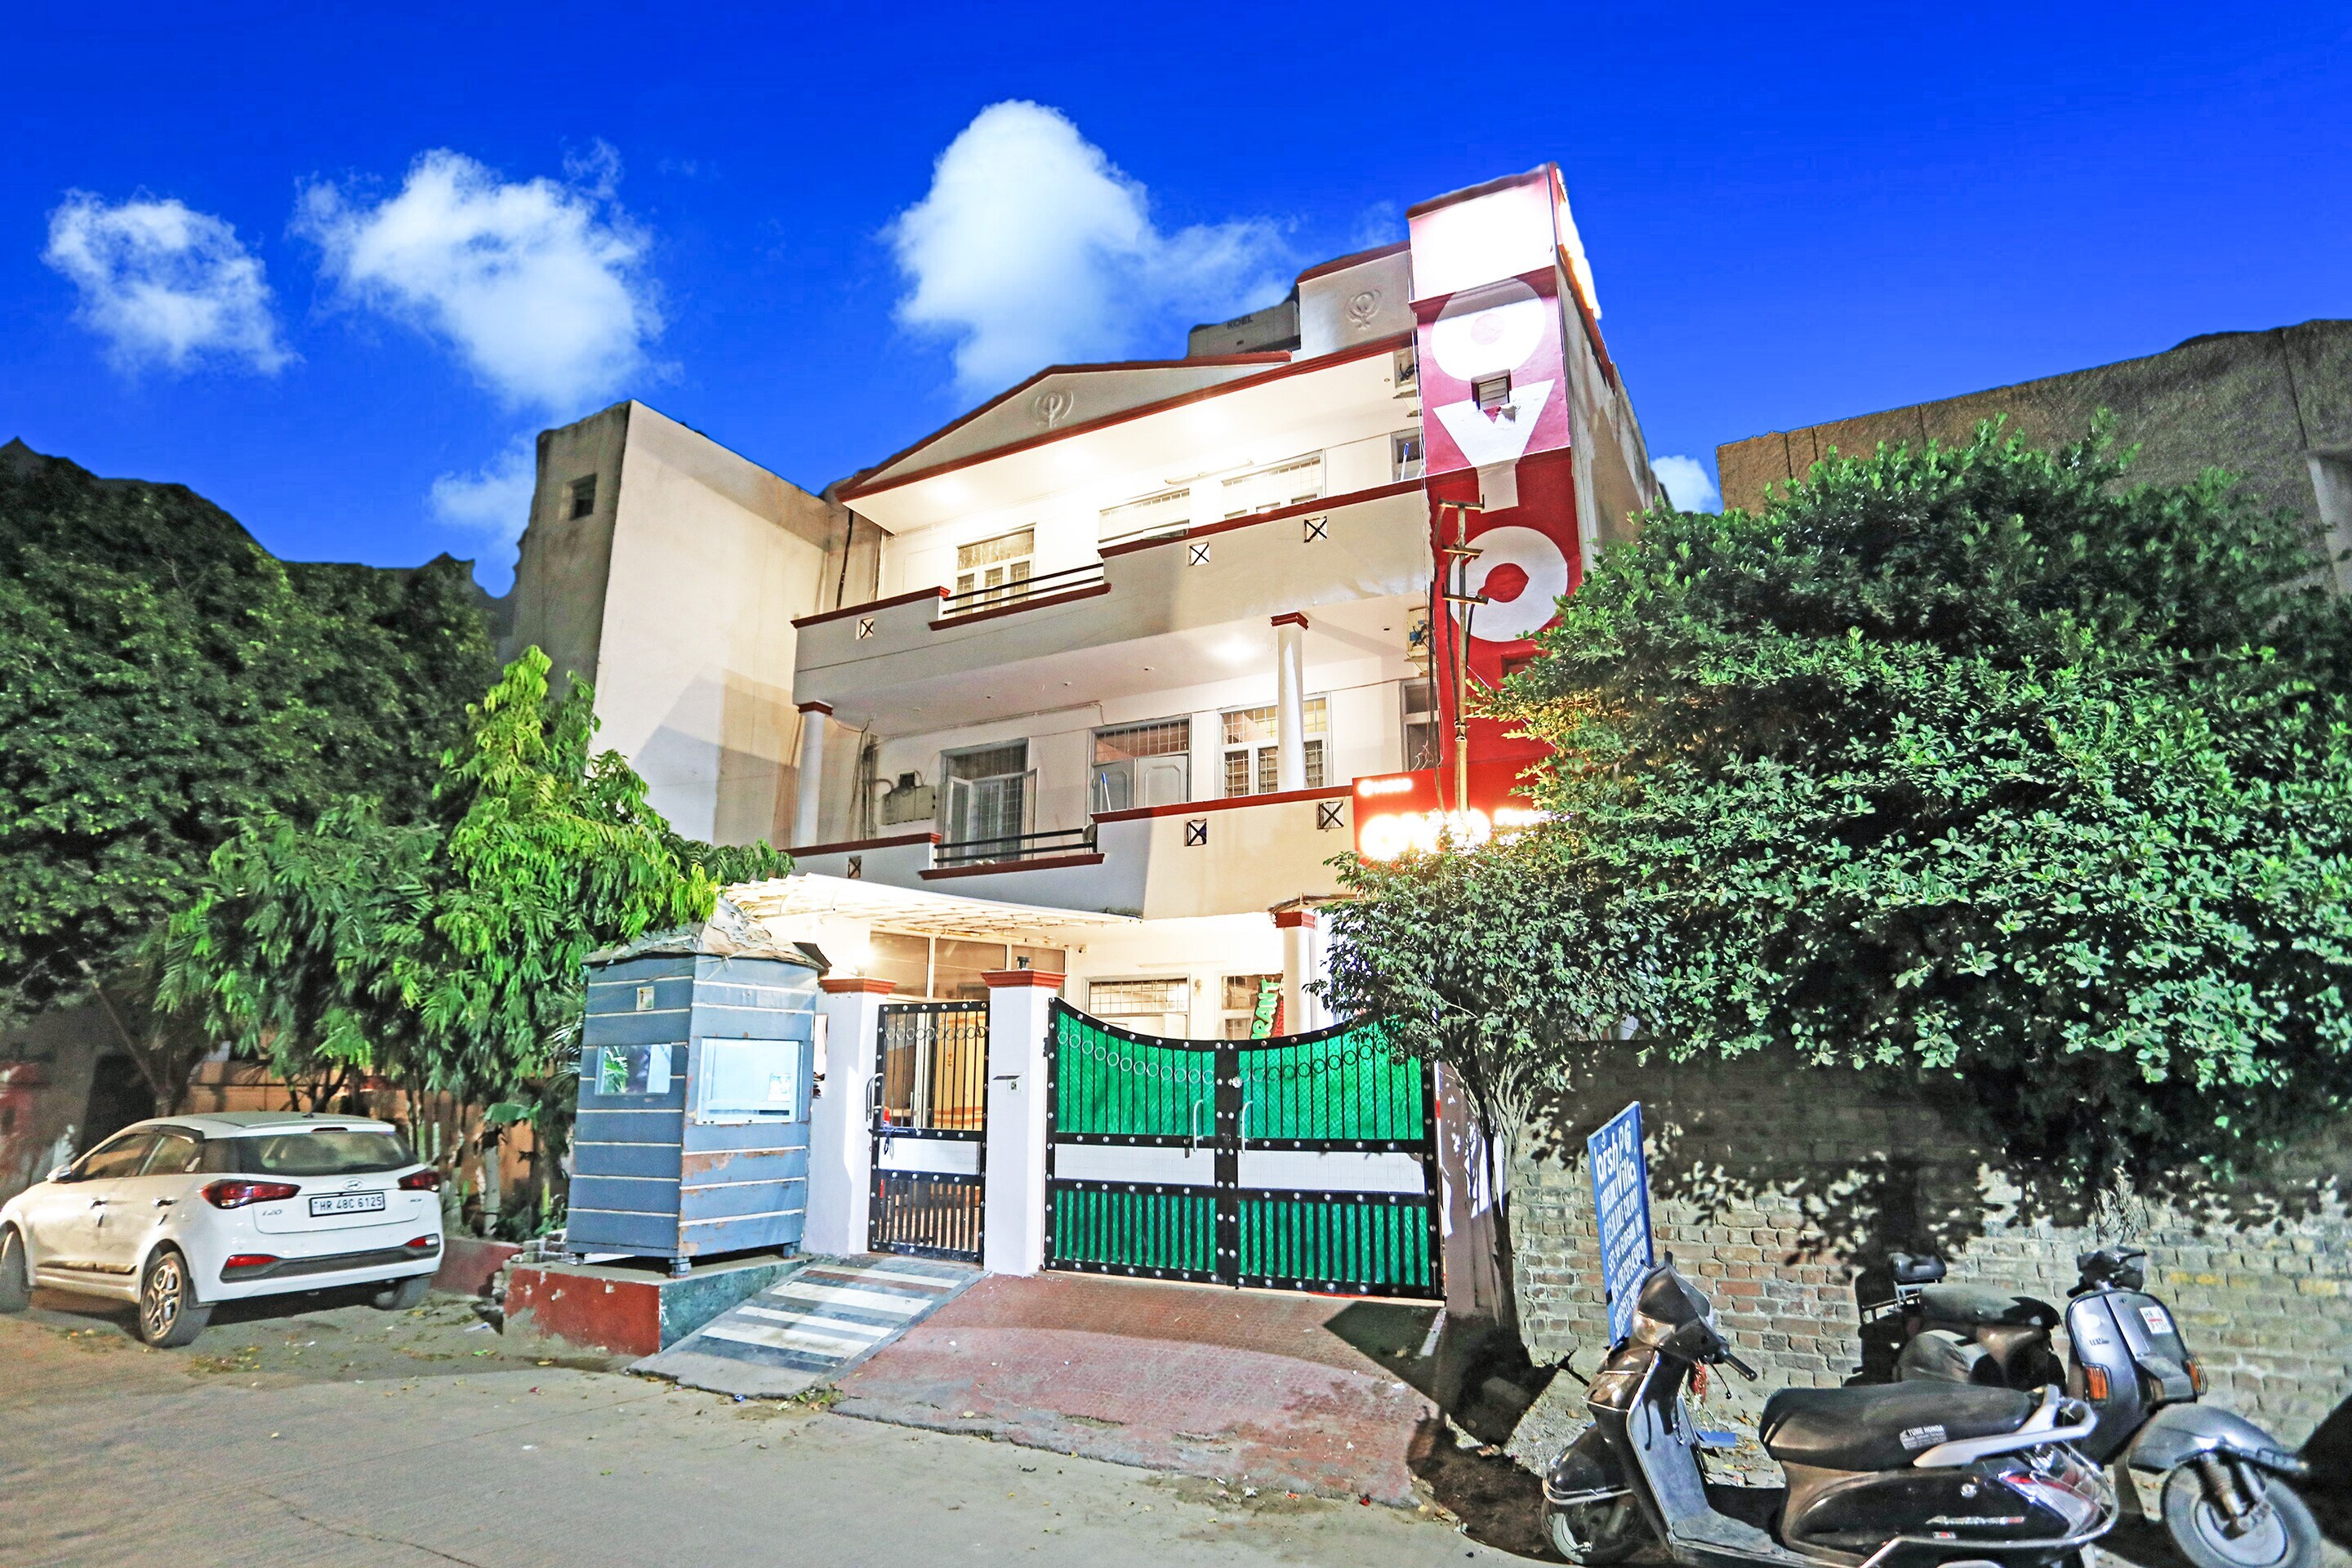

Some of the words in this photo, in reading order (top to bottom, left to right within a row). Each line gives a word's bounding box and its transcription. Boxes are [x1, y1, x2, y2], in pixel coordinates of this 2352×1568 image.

[1431, 276, 1569, 643] OYO
[1618, 1120, 1632, 1161] PG
[1616, 1156, 1637, 1196] Villa
[319, 1200, 332, 1210] HR
[336, 1199, 354, 1209] 48C
[358, 1196, 382, 1208] 6125
[1923, 1424, 1944, 1433] HONDA
